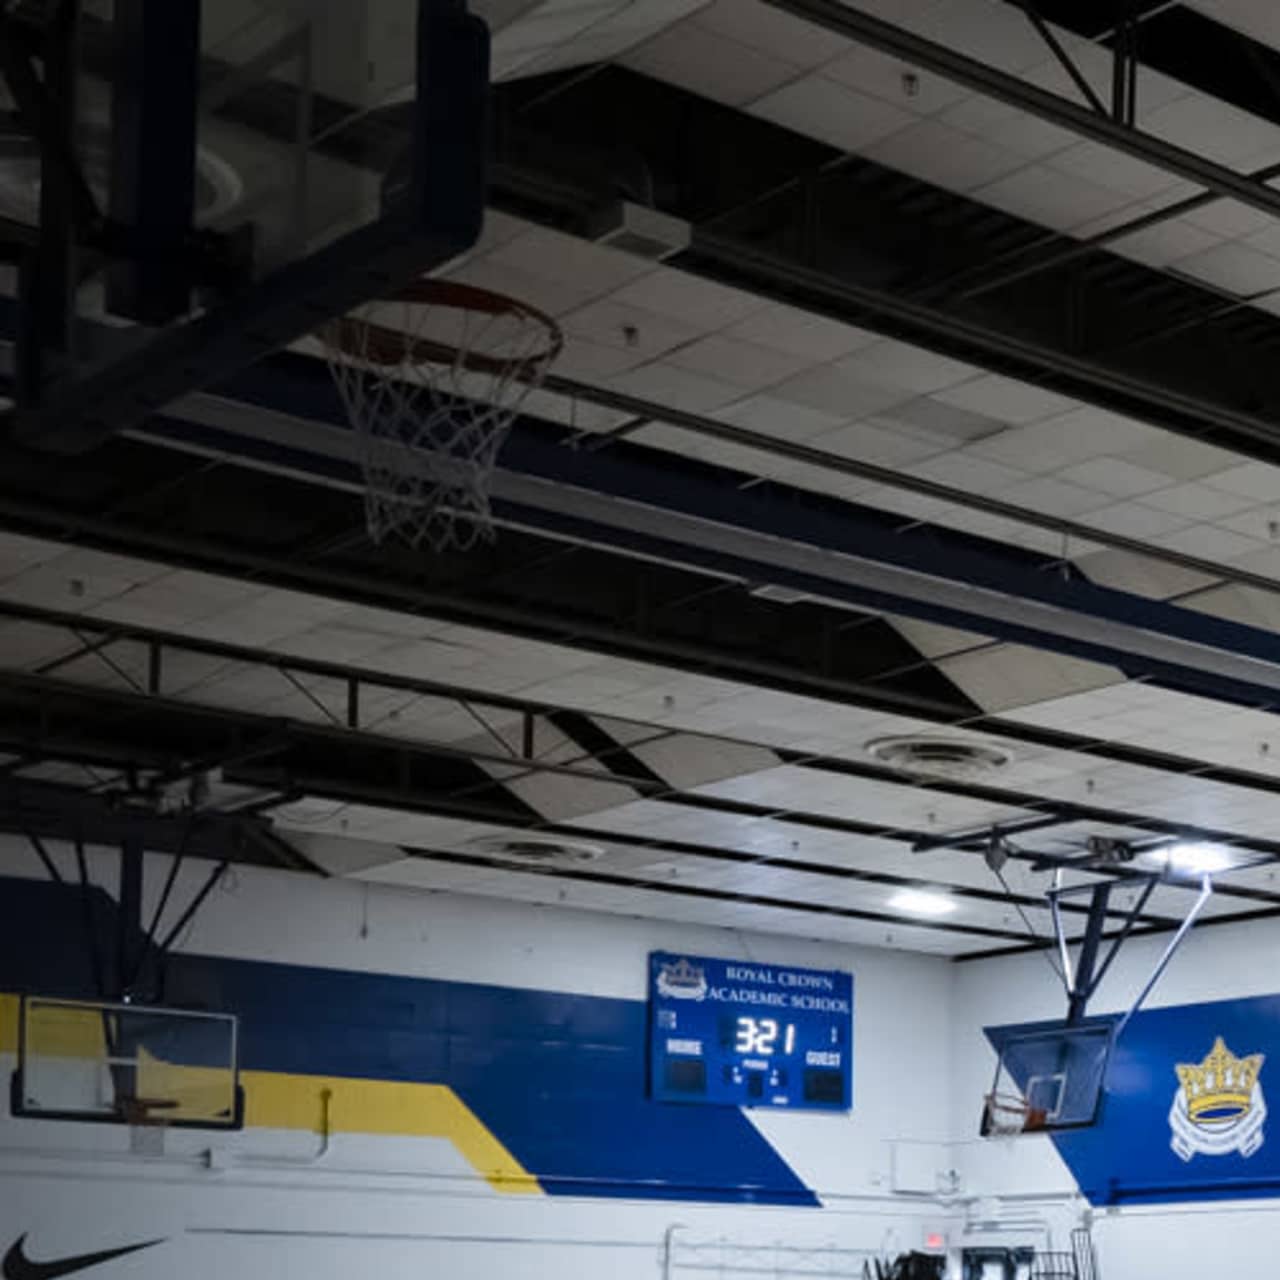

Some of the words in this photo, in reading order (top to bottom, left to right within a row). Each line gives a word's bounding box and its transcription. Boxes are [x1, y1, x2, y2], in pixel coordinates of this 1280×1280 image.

[727, 966, 774, 984] ROYAL
[778, 973, 833, 990] CROWN
[708, 986, 788, 1007] ACADEMIC
[791, 995, 849, 1014] SCHOOL
